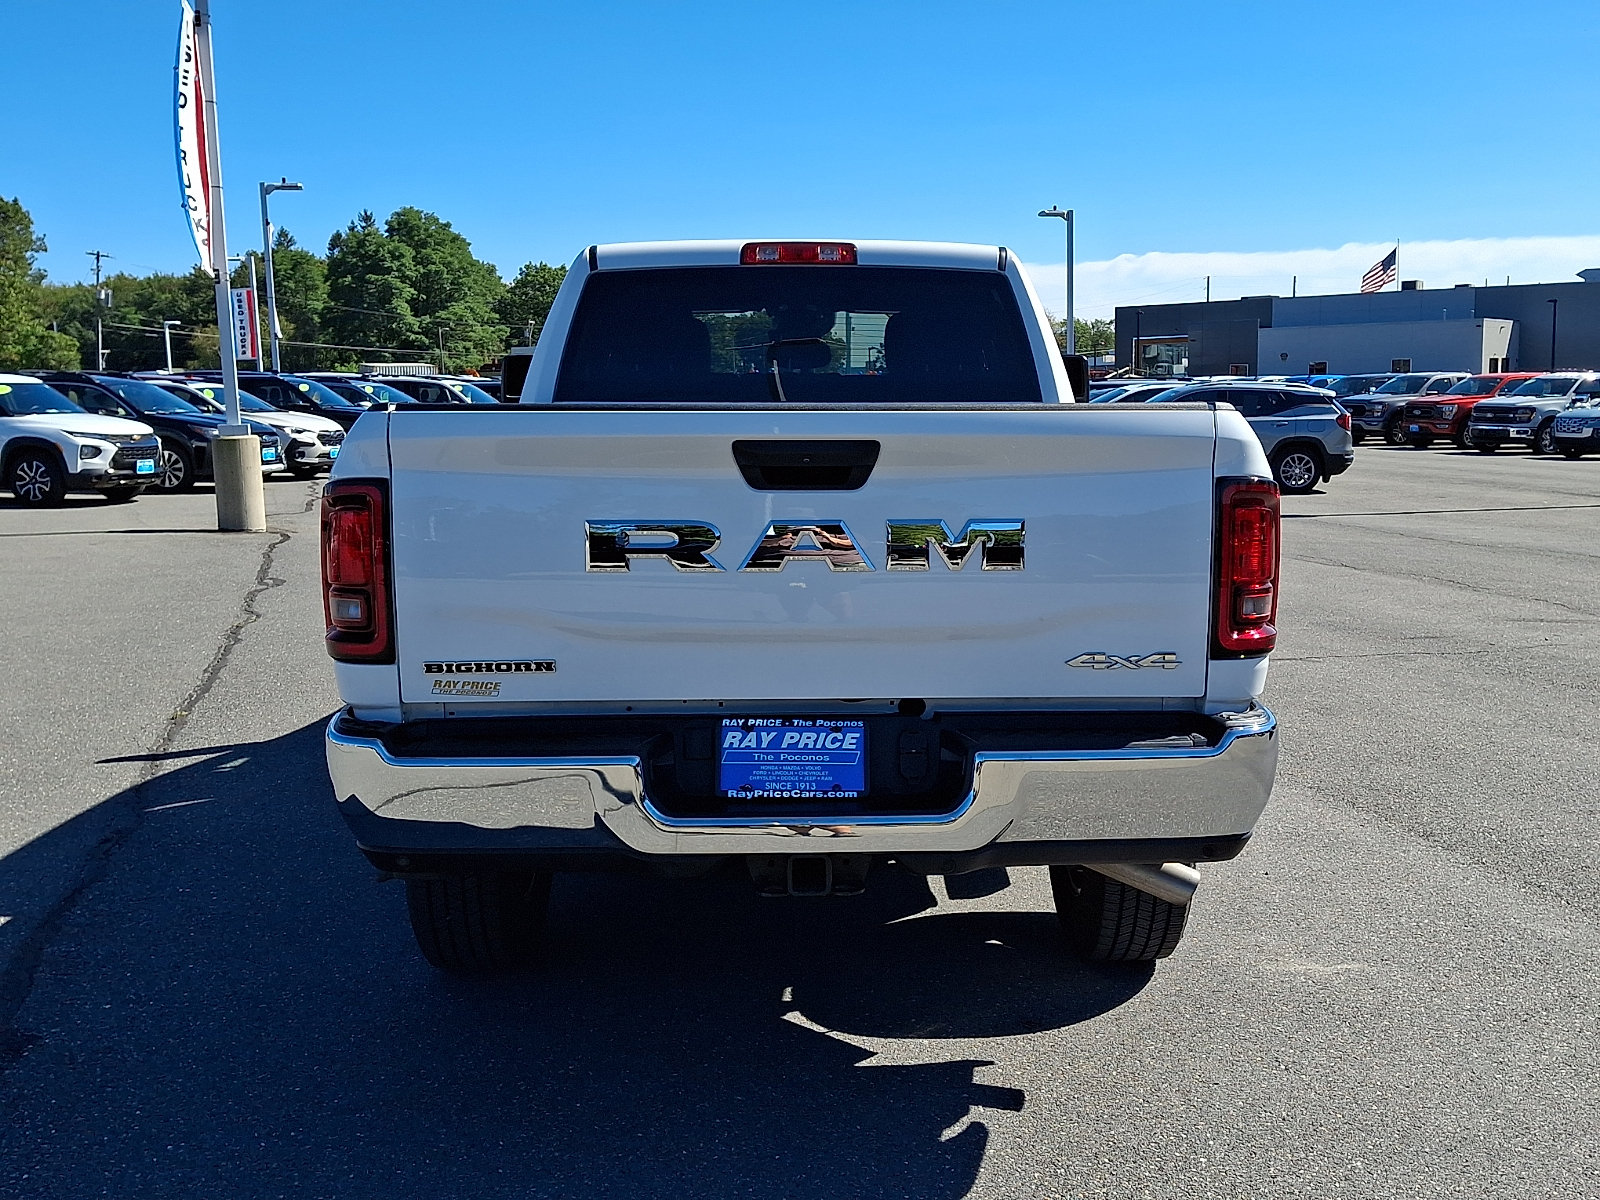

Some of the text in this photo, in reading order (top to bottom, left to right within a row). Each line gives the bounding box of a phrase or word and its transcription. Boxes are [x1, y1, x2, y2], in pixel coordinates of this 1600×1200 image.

[178, 19, 192, 109] SED
[236, 292, 247, 355] USED TRUCKS
[585, 518, 1026, 572] RAM
[423, 660, 556, 673] BIGHORN
[433, 680, 502, 690] RAY PRICE
[792, 719, 813, 727] The
[815, 719, 864, 727] Poconos
[723, 732, 861, 749] RAY PRICE
[753, 753, 830, 762] The Poconos
[765, 782, 816, 790] SINCE 1913
[727, 789, 858, 799] RayPriceCars.com
